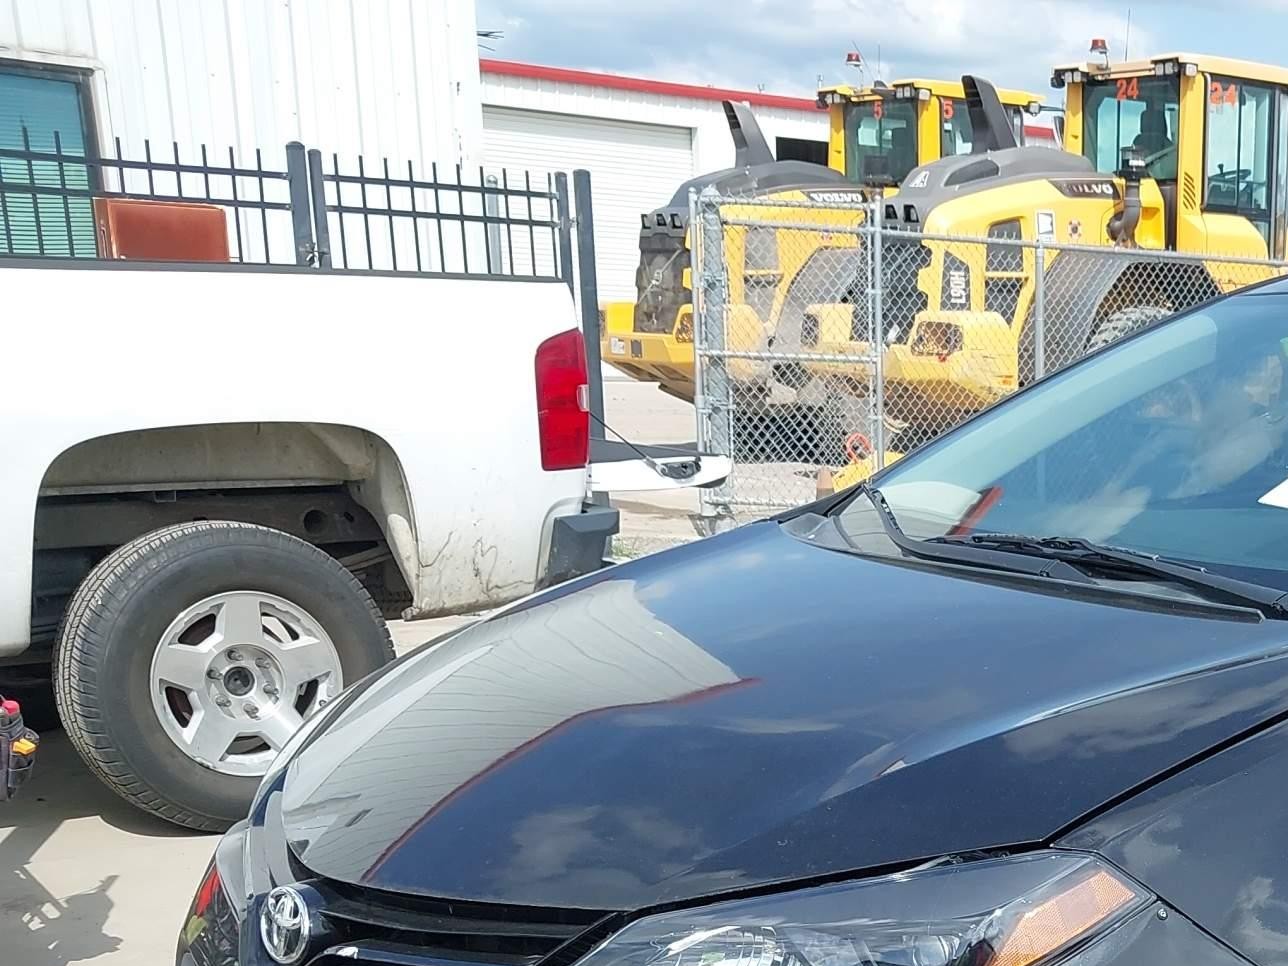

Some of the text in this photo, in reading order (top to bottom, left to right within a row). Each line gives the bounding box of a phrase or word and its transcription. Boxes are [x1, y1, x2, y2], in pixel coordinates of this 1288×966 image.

[1116, 78, 1139, 100] 24
[1209, 82, 1237, 105] 24
[943, 99, 955, 119] 5
[809, 192, 863, 203] VOLVO
